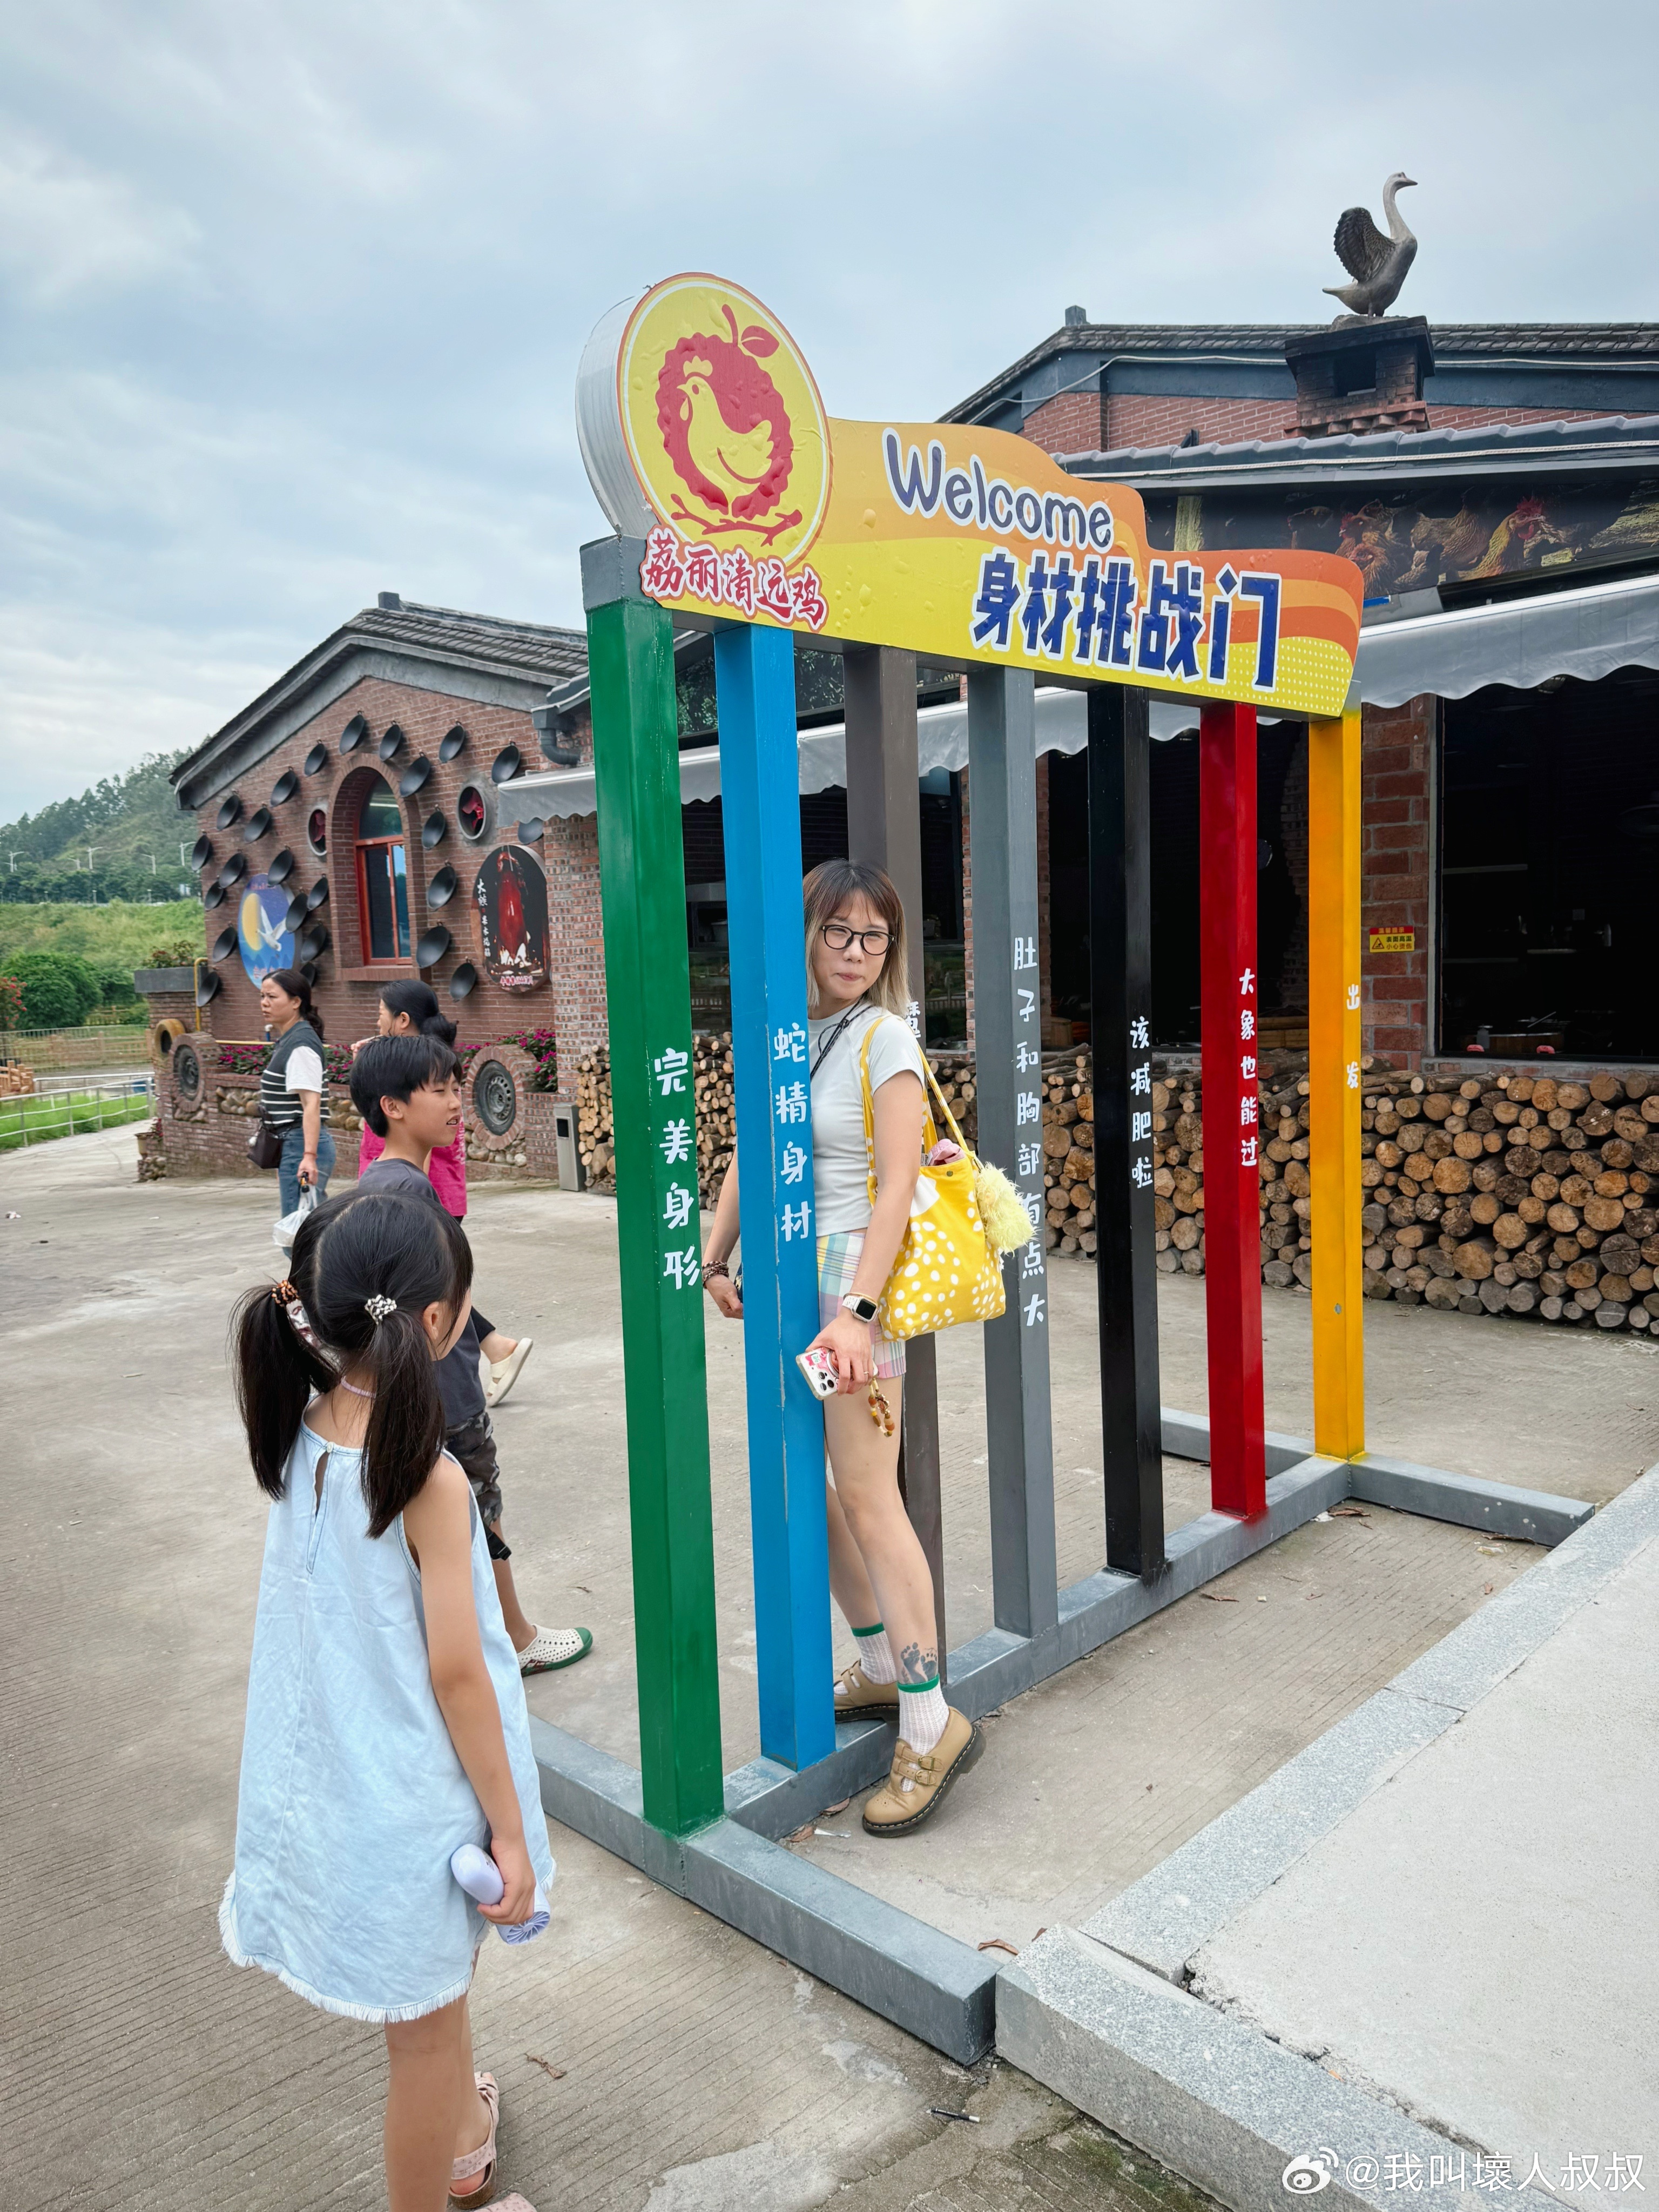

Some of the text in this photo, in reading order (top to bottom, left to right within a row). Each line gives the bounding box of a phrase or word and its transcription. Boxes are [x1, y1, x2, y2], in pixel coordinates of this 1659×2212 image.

[885, 431, 1112, 551] Welcome
[644, 530, 826, 628] 荔丽清远鸡
[972, 551, 1281, 689] 身材挑战门
[774, 1022, 812, 1242] 蛇精身材
[1130, 1015, 1153, 1189] 该减肥啦
[1239, 968, 1258, 1166] 大象也能过
[654, 1047, 701, 1290] 完美身形
